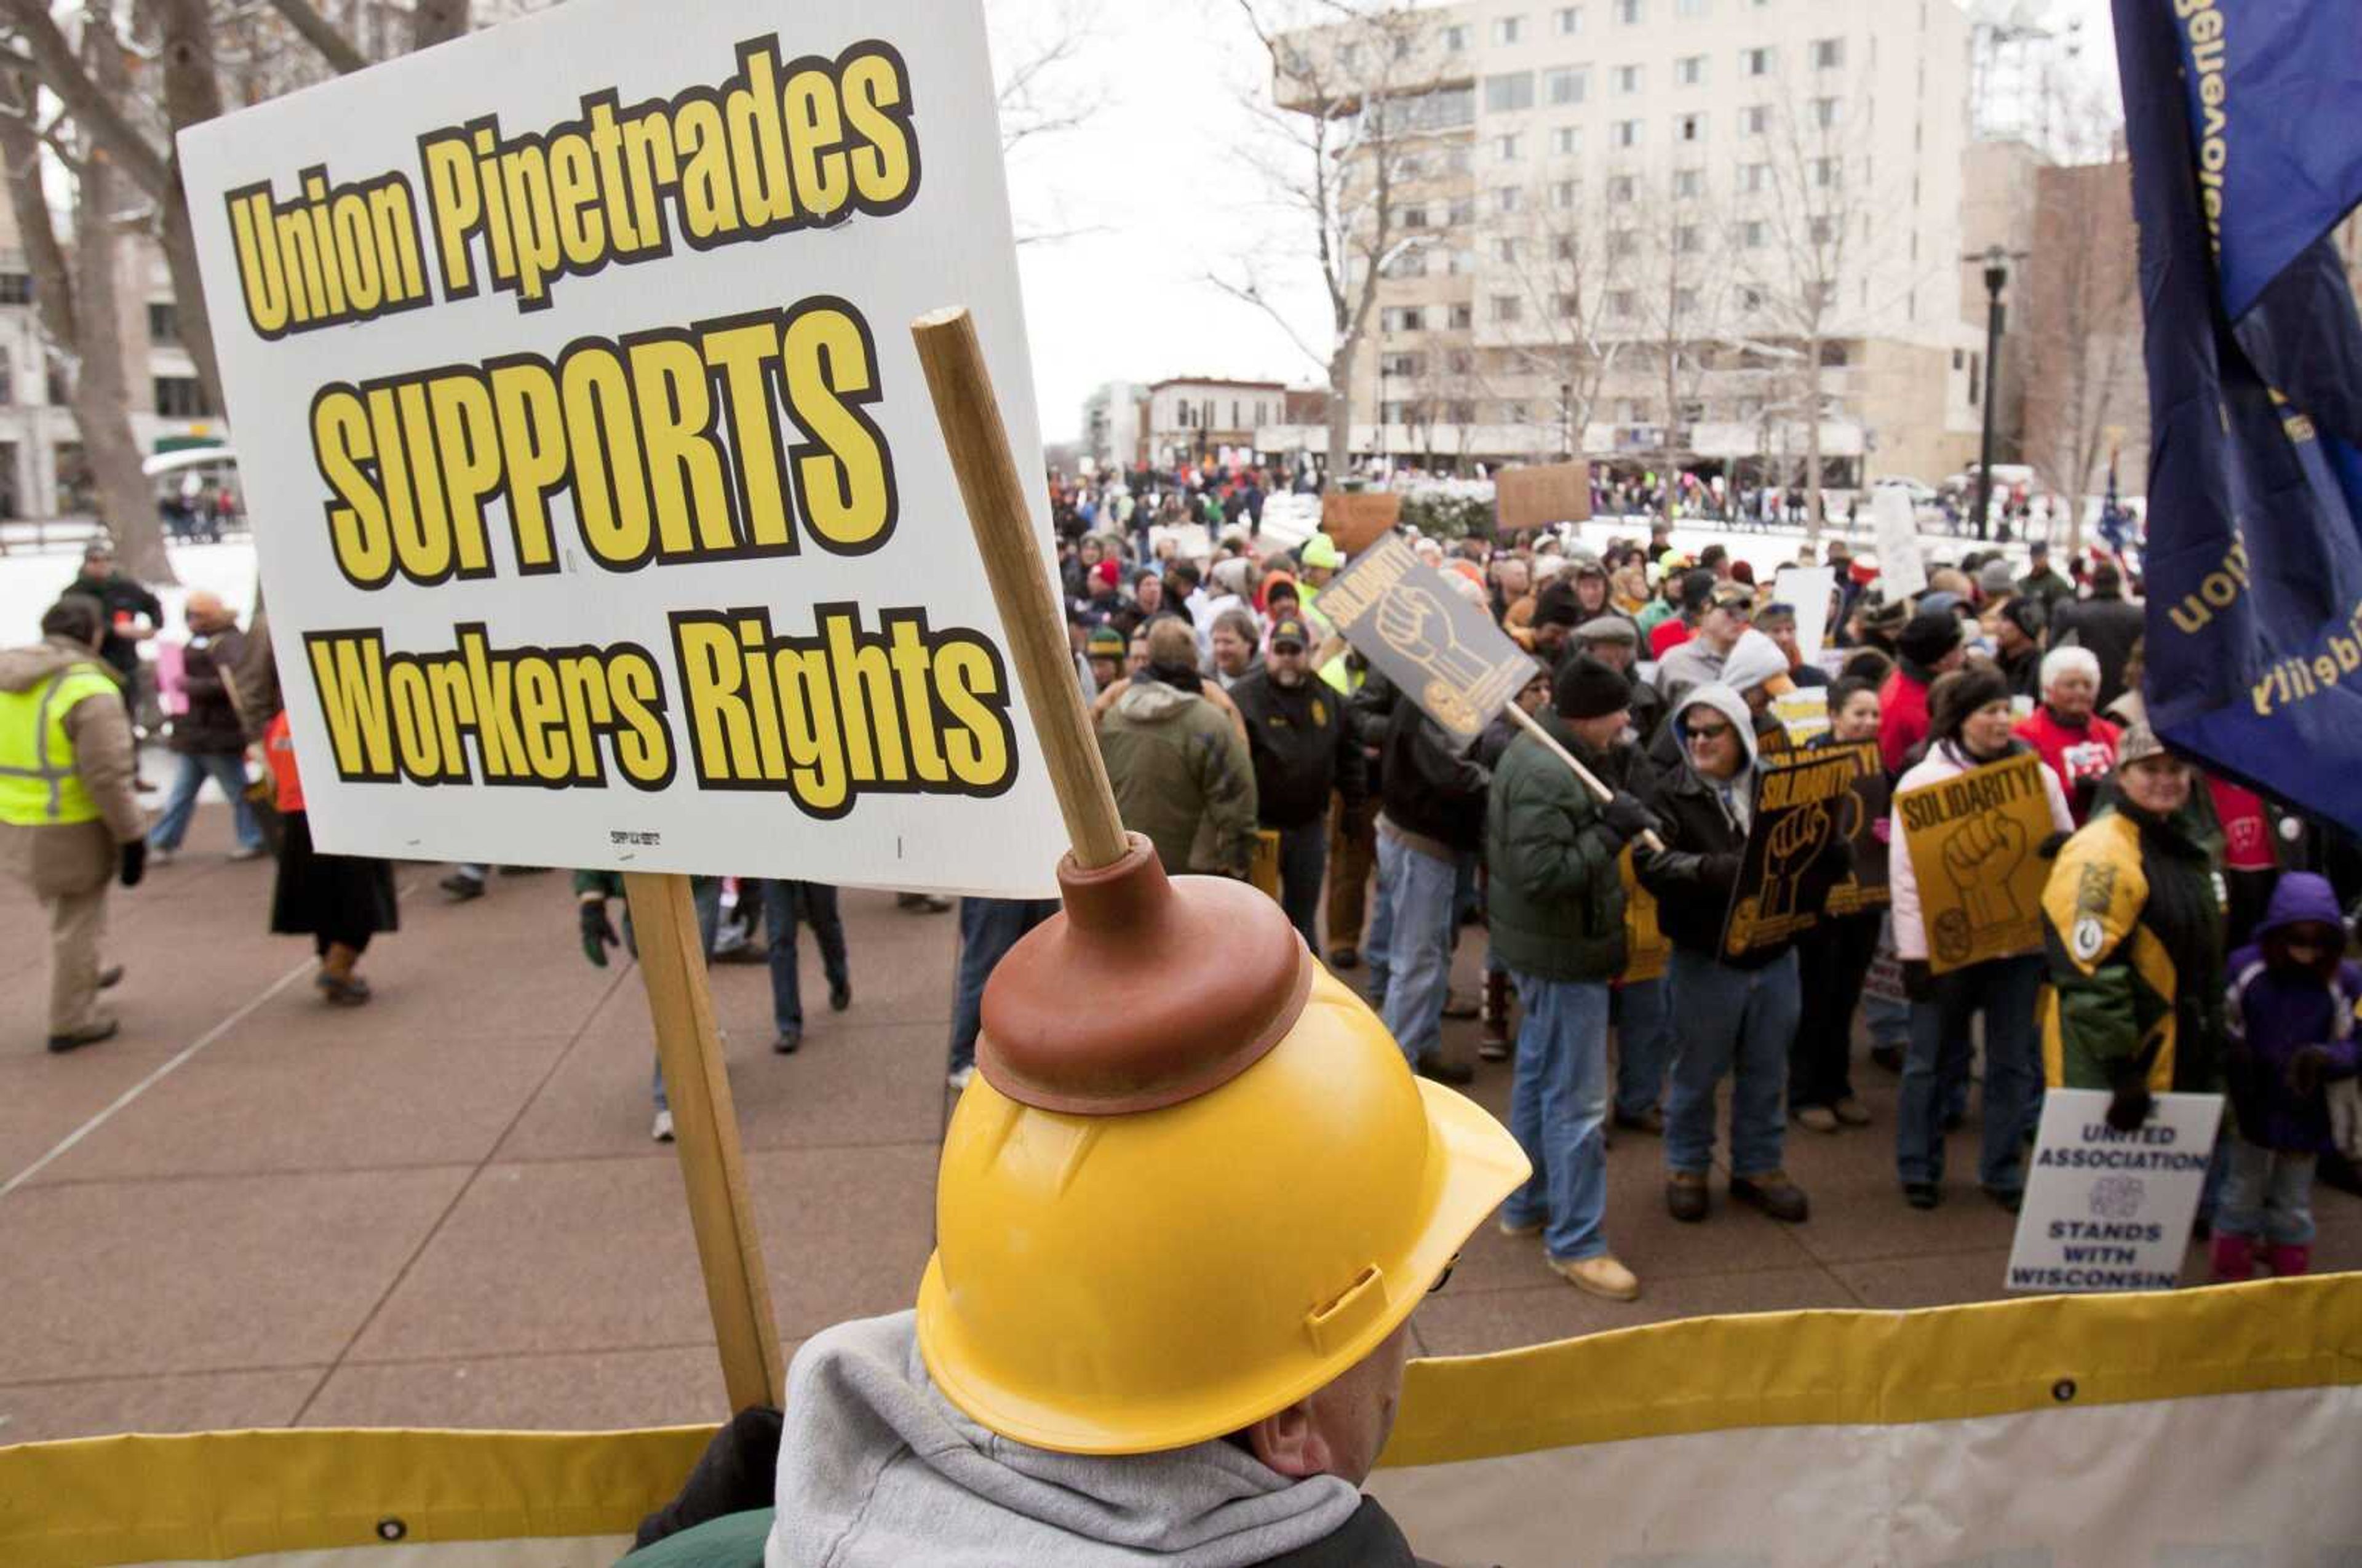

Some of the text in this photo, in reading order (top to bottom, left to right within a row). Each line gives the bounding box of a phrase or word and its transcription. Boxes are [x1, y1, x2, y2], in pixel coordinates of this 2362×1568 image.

[224, 33, 922, 341] Union Pipetrades
[309, 294, 897, 591] SUPPORTS
[303, 601, 1019, 821] Workers Rights
[2037, 1148, 2211, 1171] ASSOCIATION
[2049, 1221, 2163, 1241] STANDS
[2064, 1246, 2136, 1264] WITH
[2011, 1267, 2175, 1287] WISCONSIN
